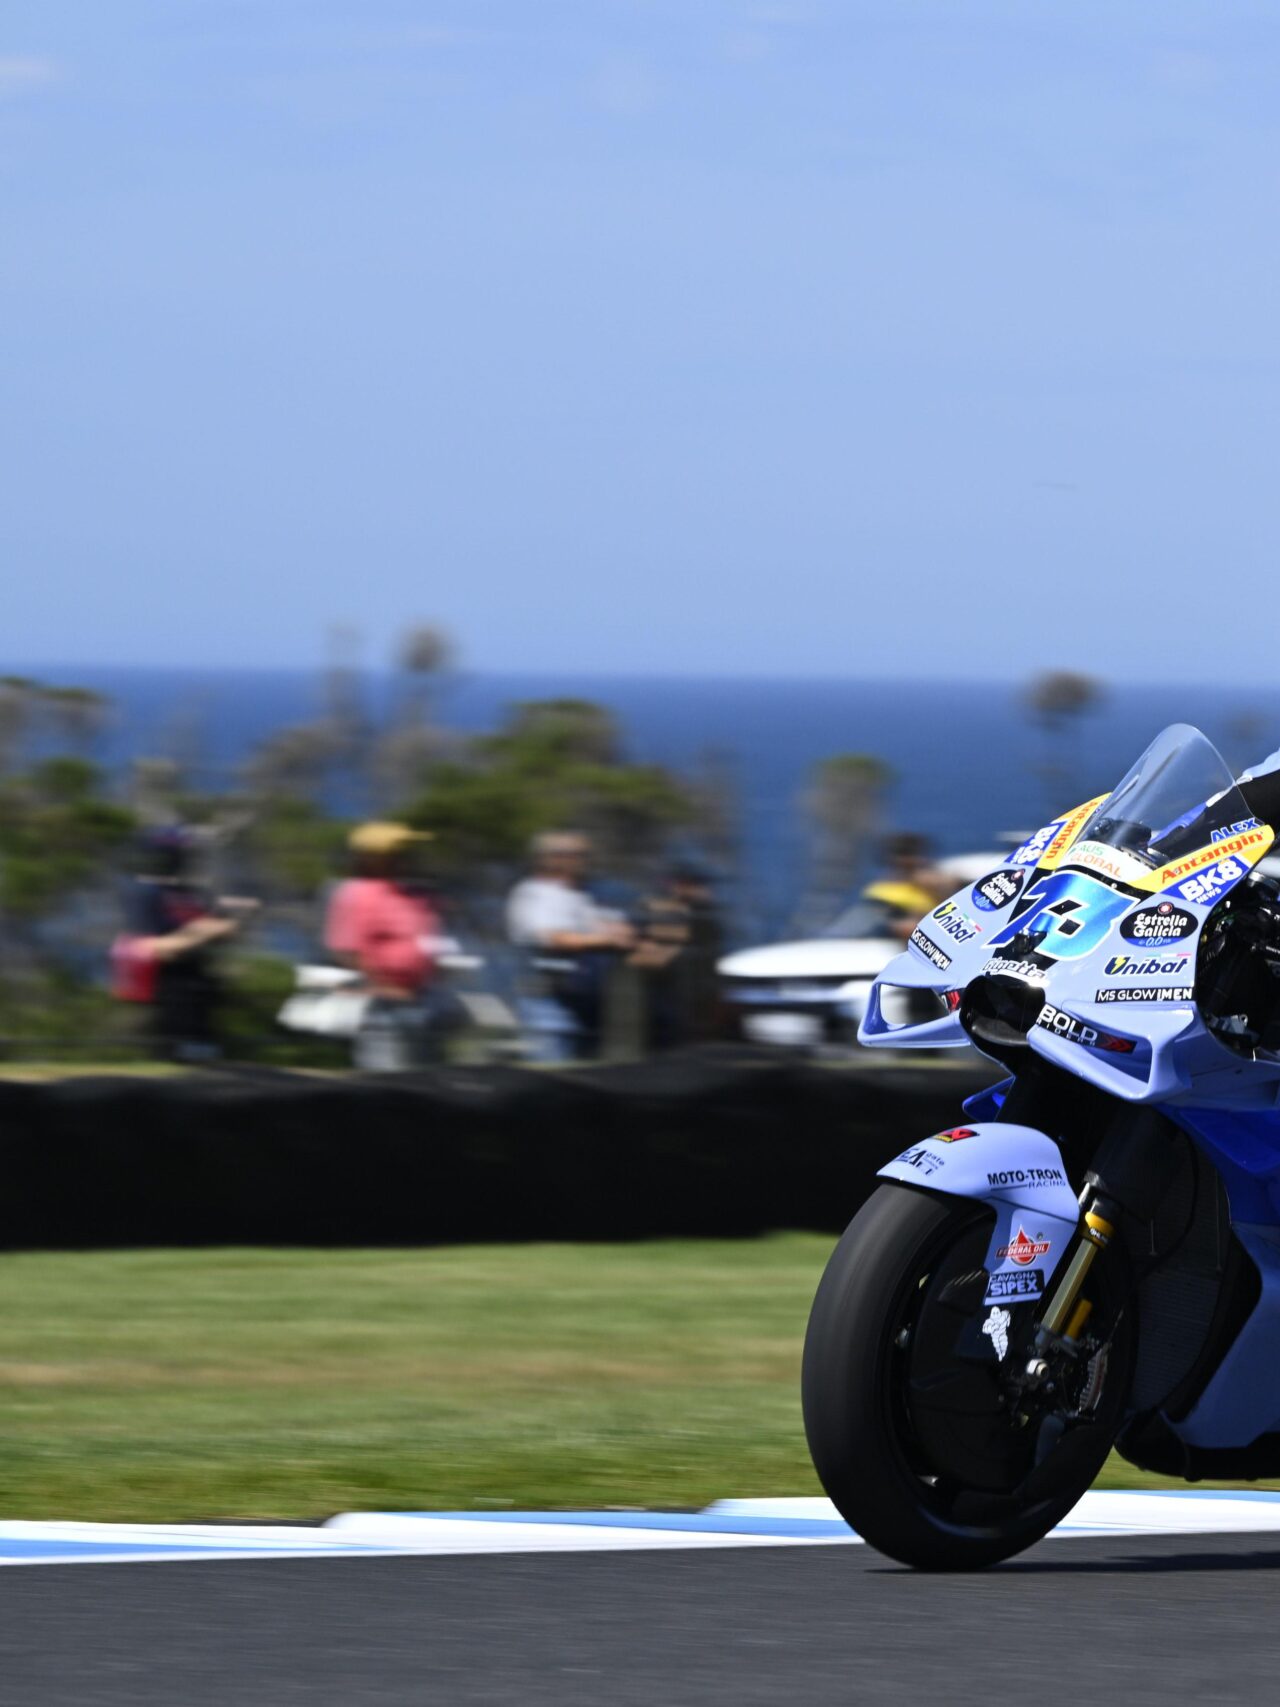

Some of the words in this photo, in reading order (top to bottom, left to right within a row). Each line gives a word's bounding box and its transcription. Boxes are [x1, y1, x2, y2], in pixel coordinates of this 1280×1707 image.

[1211, 817, 1259, 843] ALEX
[1161, 831, 1262, 884] Antangin
[1178, 859, 1243, 902] BK8
[1196, 887, 1222, 905] NEWS
[933, 902, 976, 943] Unibat
[1134, 913, 1188, 927] Estrella
[1133, 926, 1182, 938] Galicia
[1105, 956, 1189, 975] Unibat
[1097, 989, 1116, 1001] MS
[1117, 989, 1157, 1001] GLOW
[1039, 1004, 1098, 1042] BOLD
[987, 1169, 1063, 1186] MOTO-TRON
[1028, 1181, 1066, 1189] RACING
[1034, 1244, 1046, 1253] OIL
[990, 1279, 1038, 1297] SIPEX
